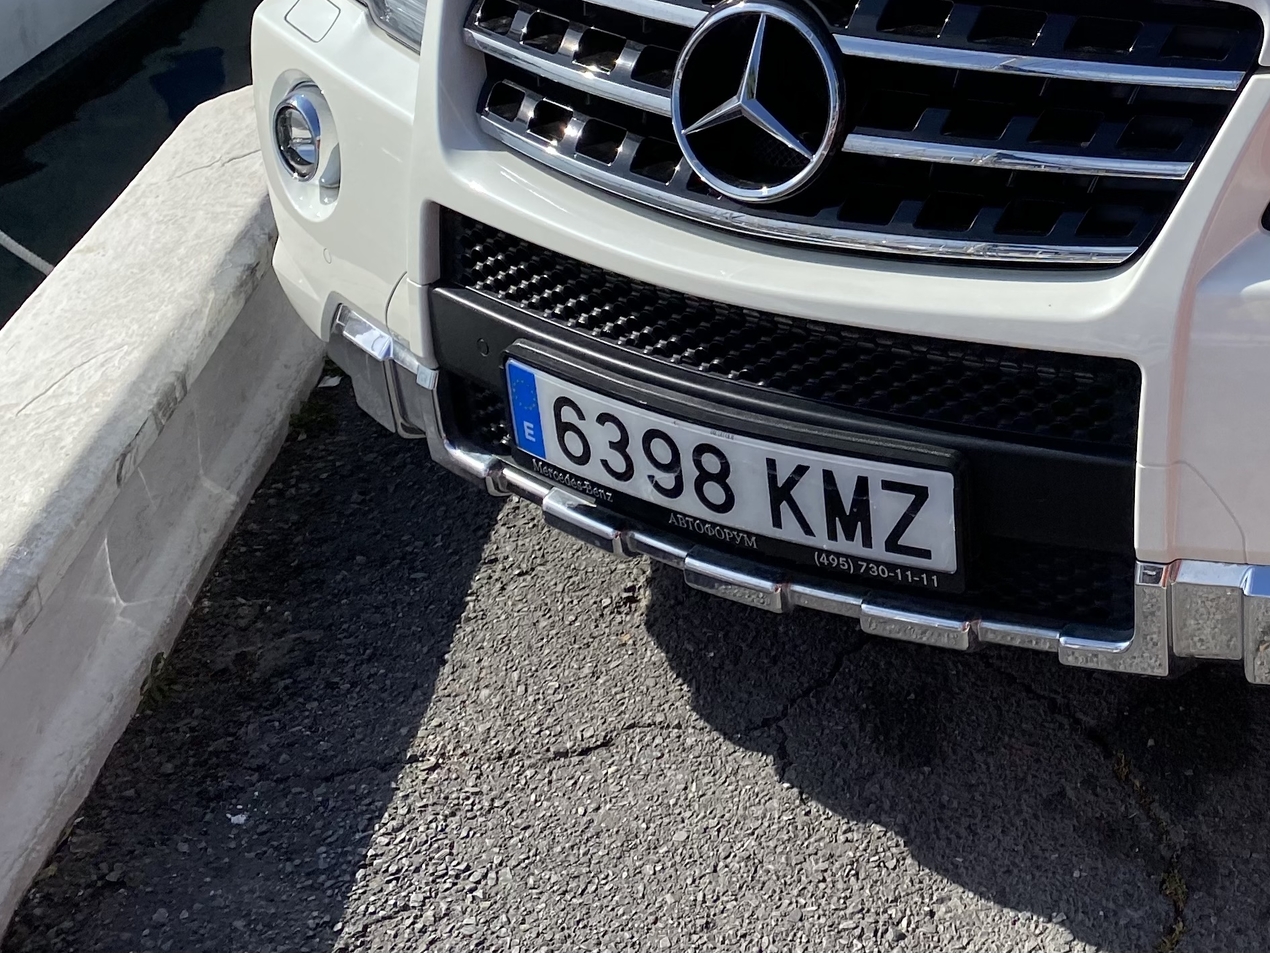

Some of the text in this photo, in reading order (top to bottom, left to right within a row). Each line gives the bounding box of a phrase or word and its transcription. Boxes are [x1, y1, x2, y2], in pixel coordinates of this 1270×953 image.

[523, 420, 536, 442] E
[532, 458, 614, 503] Mercedes-Benz
[552, 396, 933, 560] 6398 KMZ
[668, 512, 758, 549] АВТОФОРУМ
[814, 551, 939, 588] (495) 730-11-11
